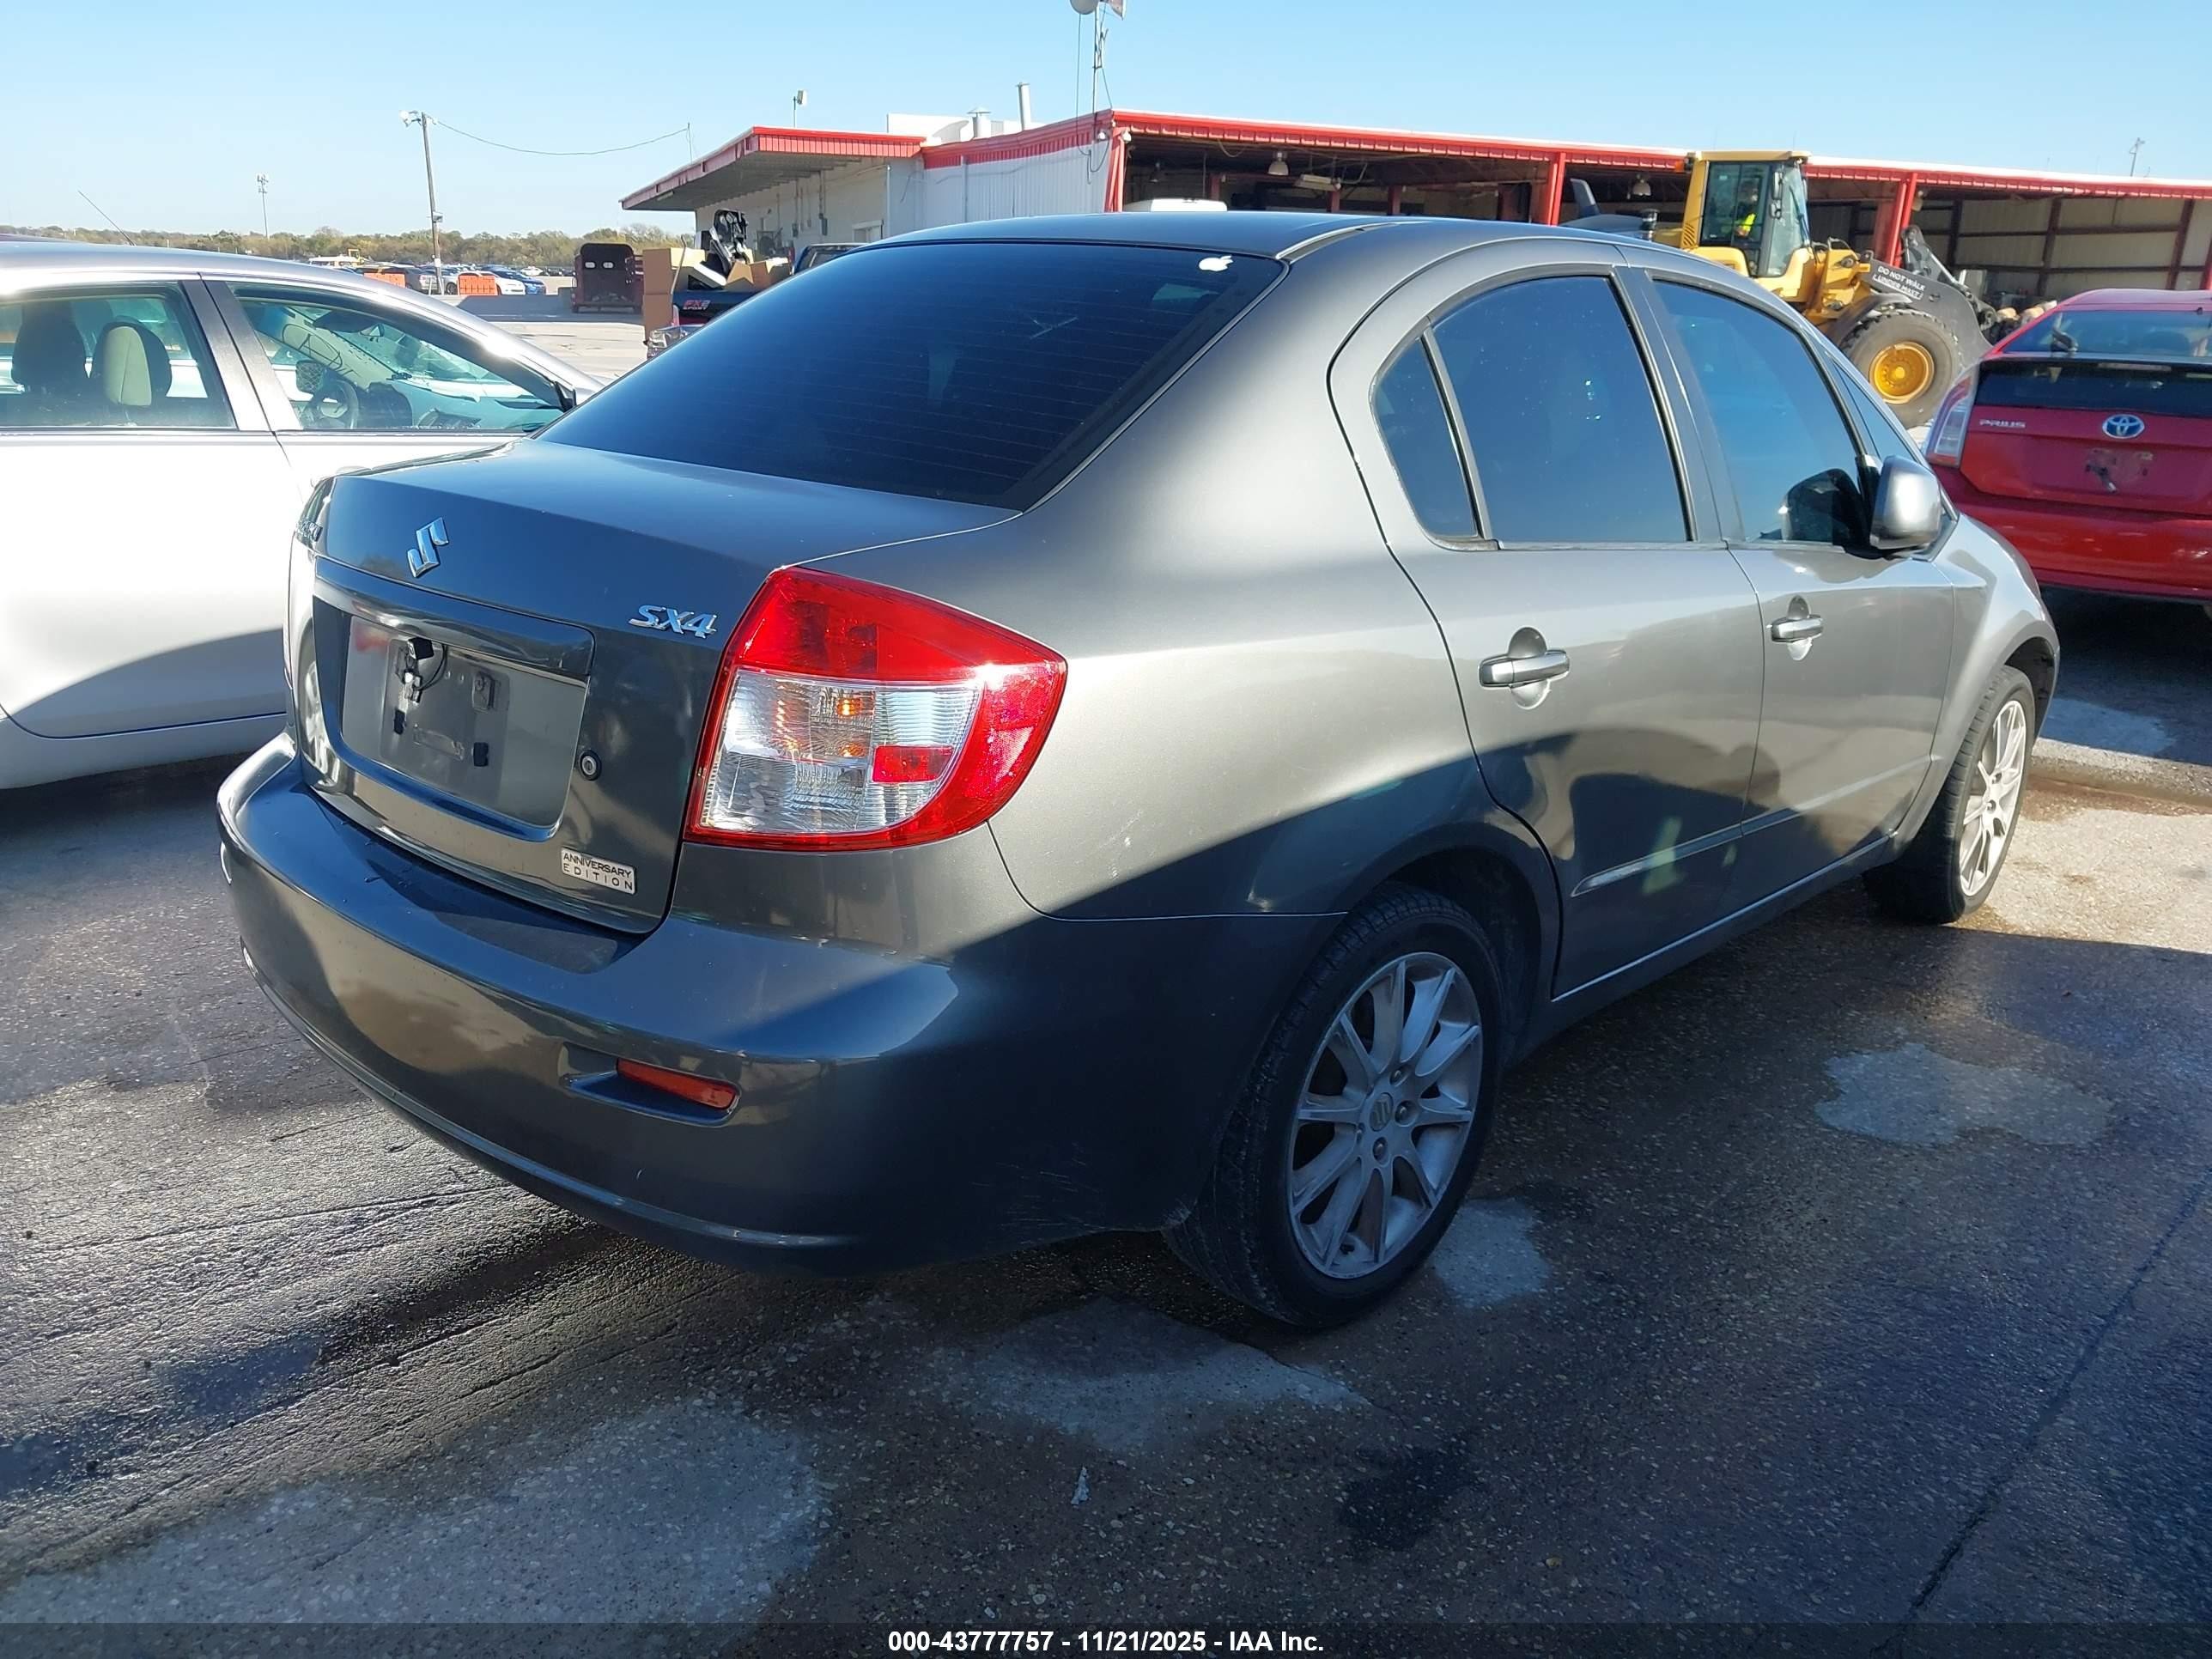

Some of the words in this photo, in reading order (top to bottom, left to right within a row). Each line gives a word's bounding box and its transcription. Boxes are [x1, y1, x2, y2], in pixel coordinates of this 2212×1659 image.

[1877, 265, 1890, 276] DO
[1889, 270, 1906, 283] NOT
[1905, 277, 1926, 291] WALK
[1979, 418, 2027, 428] PRIUS
[628, 605, 718, 639] SX4
[563, 853, 632, 879] ANNIVERSARY
[563, 863, 633, 890] EDITION
